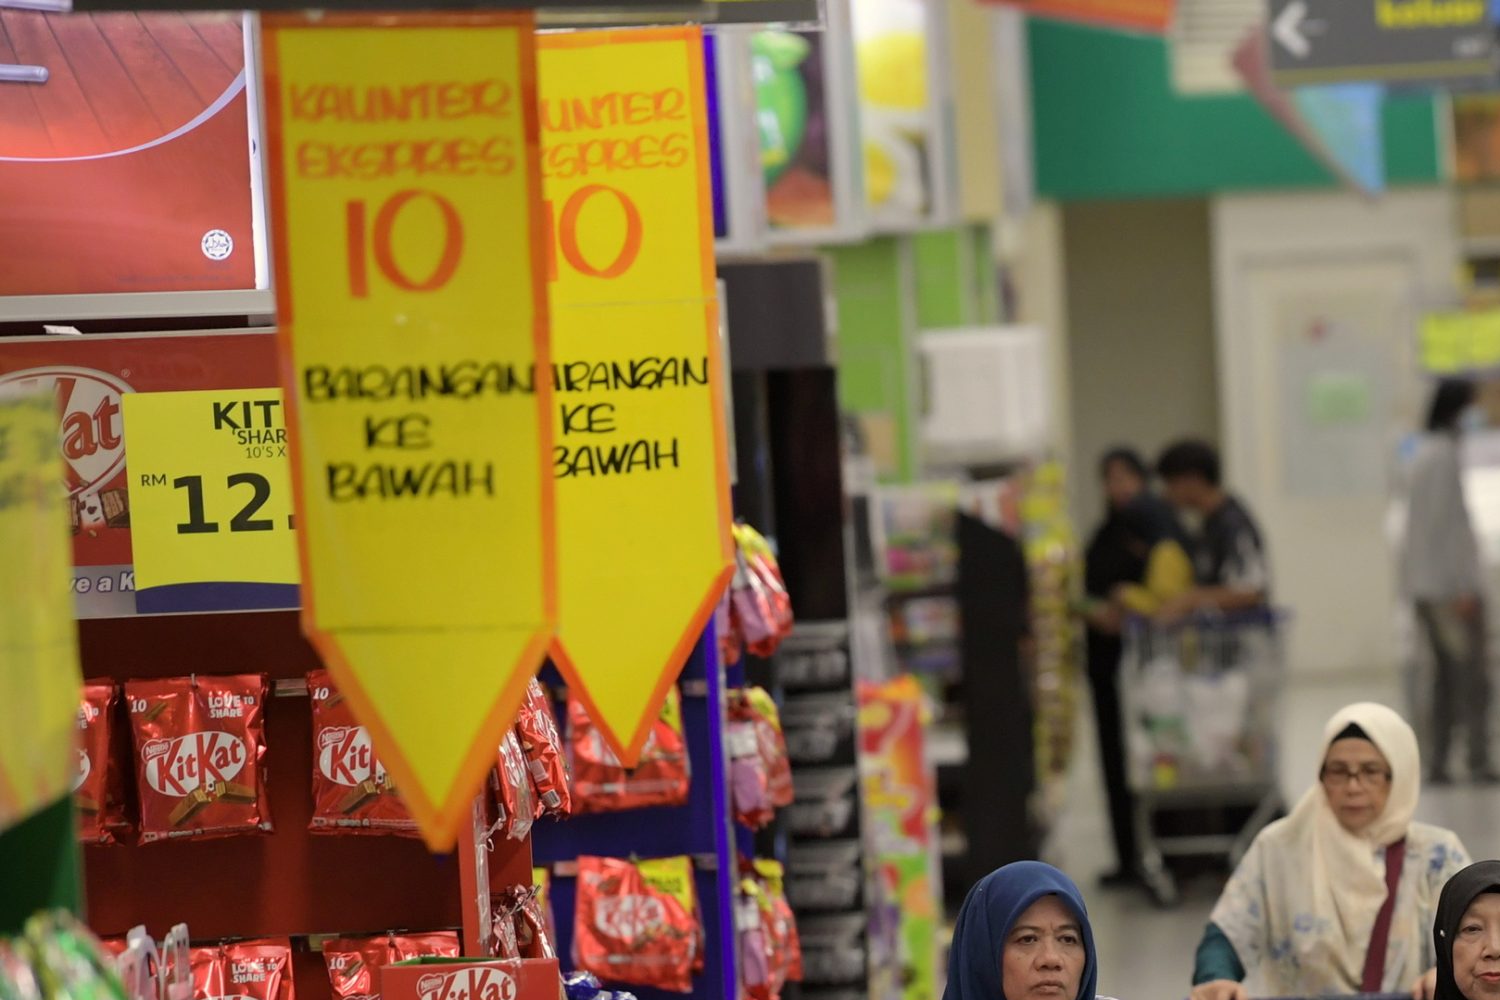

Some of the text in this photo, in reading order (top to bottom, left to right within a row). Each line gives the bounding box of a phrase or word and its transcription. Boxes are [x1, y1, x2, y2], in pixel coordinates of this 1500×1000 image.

[290, 79, 513, 124] KAUNTER
[542, 88, 687, 132] UNTER
[297, 136, 516, 181] EKSPRES
[346, 190, 463, 298] 10
[304, 361, 534, 401] BARANGAN
[213, 400, 280, 430] KIT
[562, 403, 617, 435] KE
[365, 414, 433, 450] KE
[141, 474, 167, 487] RM
[327, 462, 495, 502] BAWAH
[131, 699, 147, 713] 10
[208, 695, 254, 709] LOVE TO
[313, 687, 329, 700] 10
[210, 708, 243, 719] SHARE
[157, 732, 242, 795] KitKat
[232, 972, 266, 984] SHARE
[330, 957, 345, 970] 10
